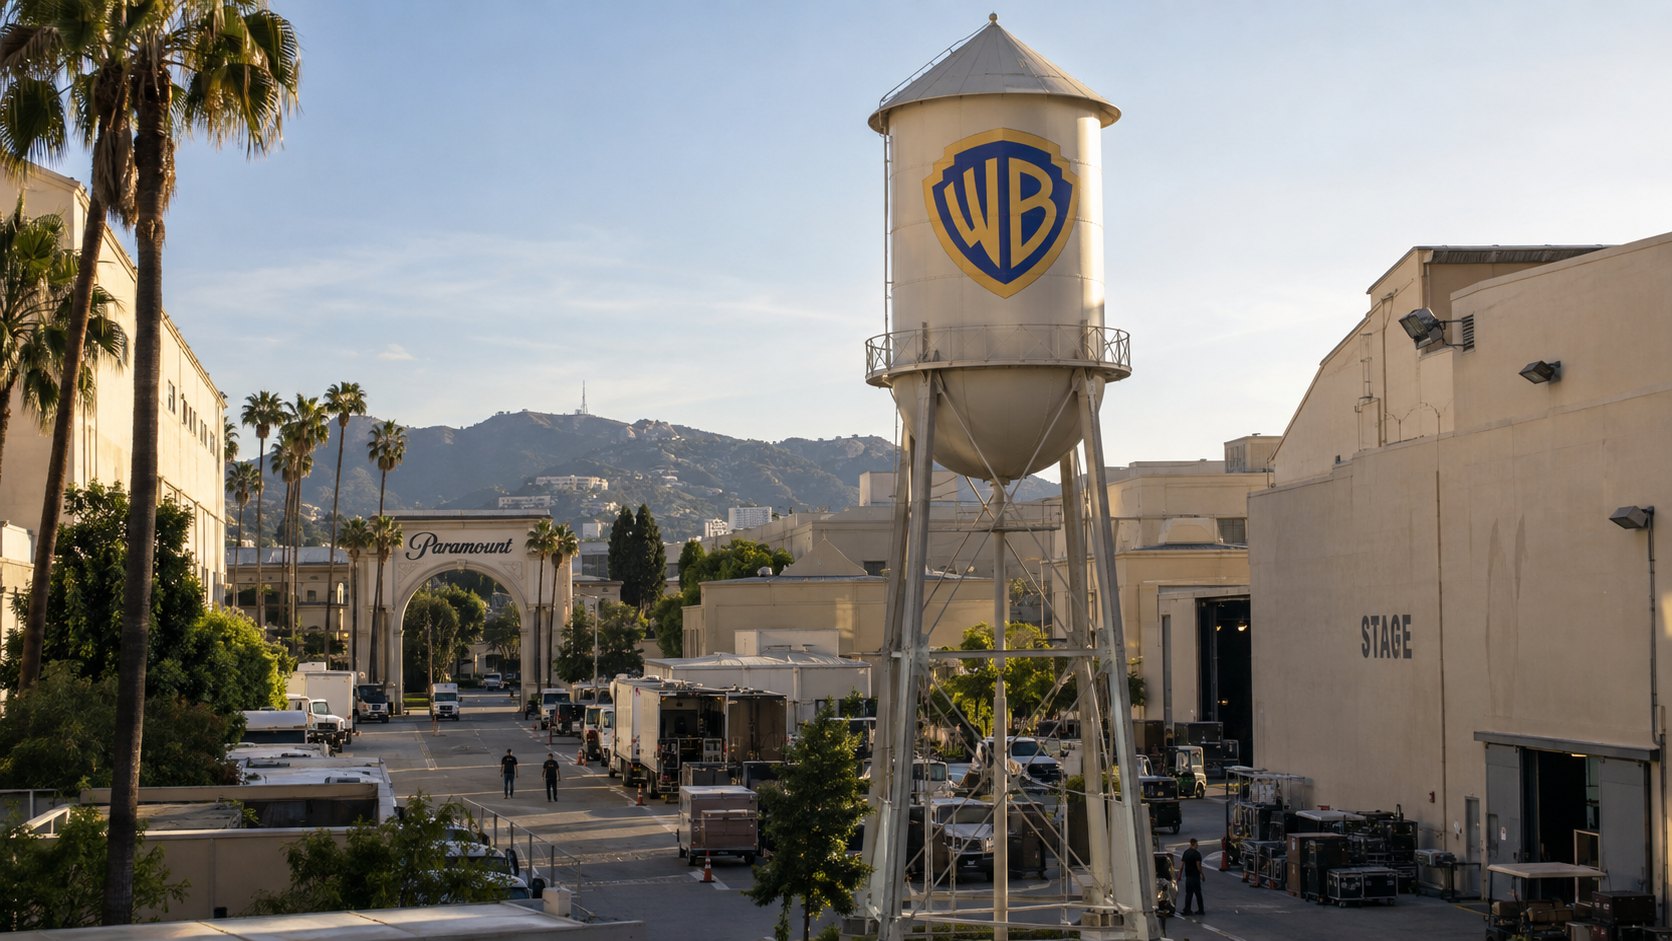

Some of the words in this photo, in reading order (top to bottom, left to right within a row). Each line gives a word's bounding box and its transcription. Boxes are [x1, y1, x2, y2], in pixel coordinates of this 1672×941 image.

[944, 157, 1057, 269] WB
[405, 532, 513, 560] Paramount
[1362, 614, 1412, 659] STAGE
